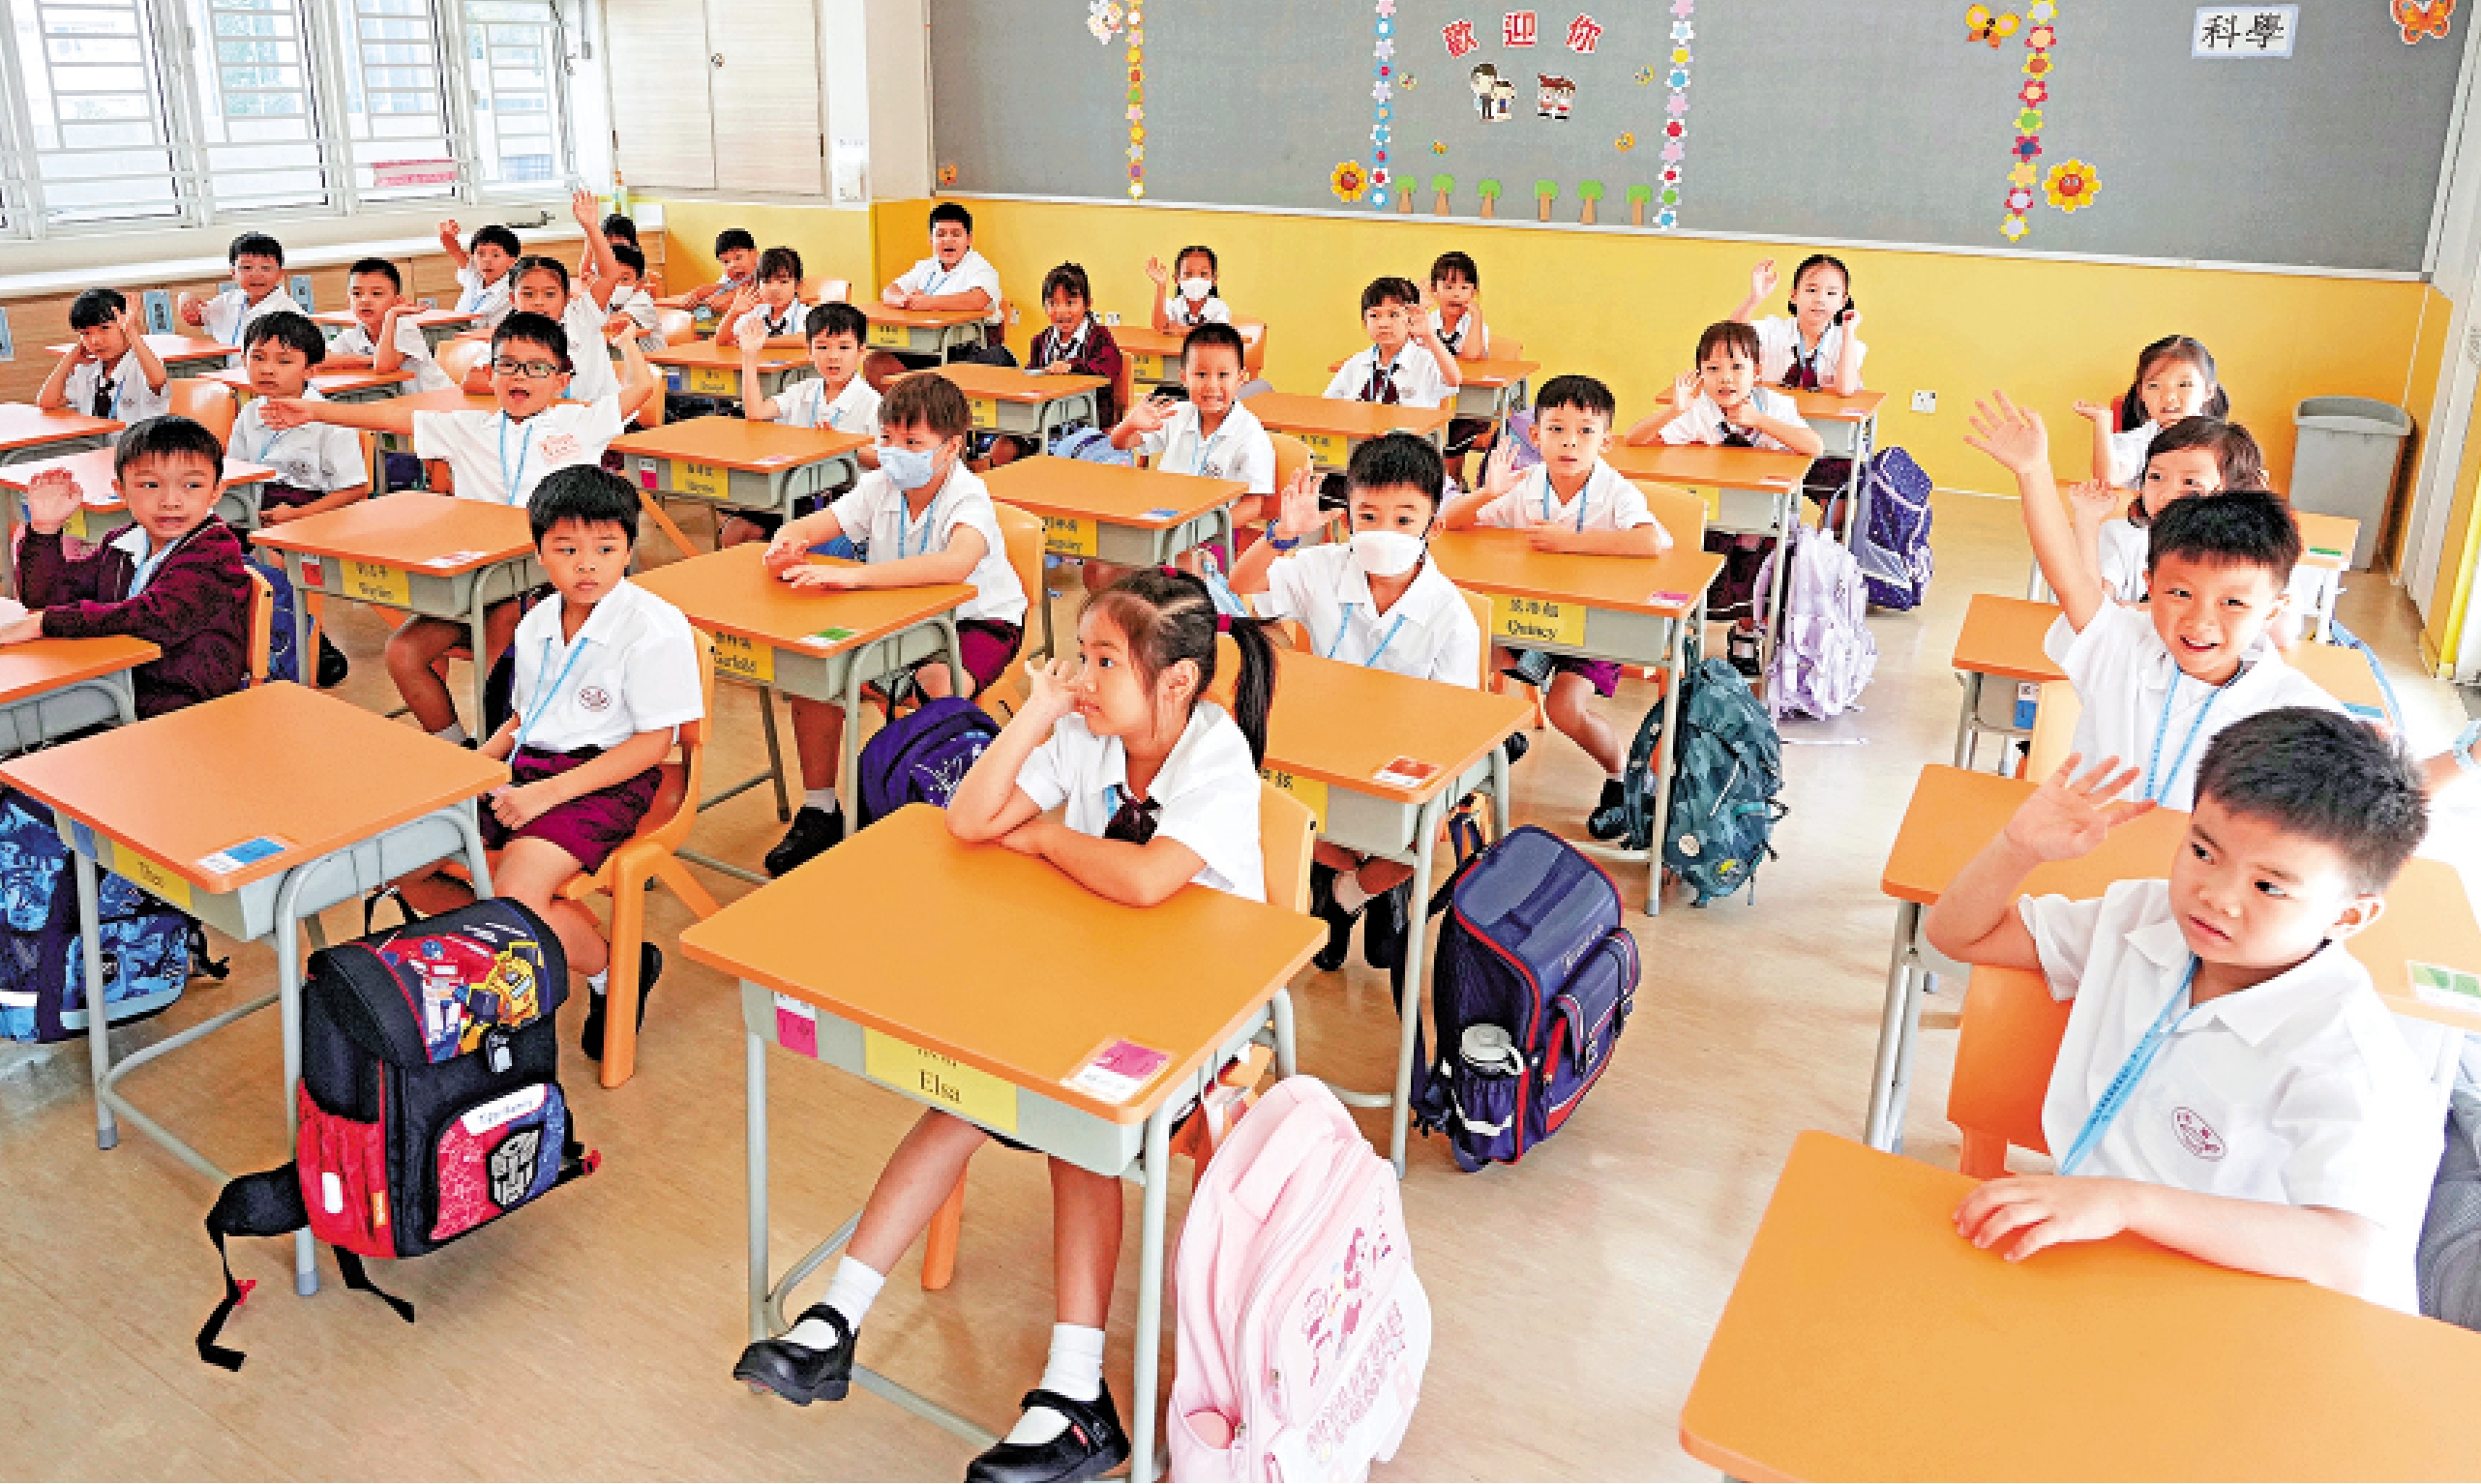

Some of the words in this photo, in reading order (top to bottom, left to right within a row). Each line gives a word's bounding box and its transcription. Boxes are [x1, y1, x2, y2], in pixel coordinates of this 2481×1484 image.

[1443, 14, 1603, 57] 歡迎你
[2199, 13, 2286, 50] 科學
[1508, 620, 1557, 640] Quincy
[920, 1069, 961, 1103] Elsa
